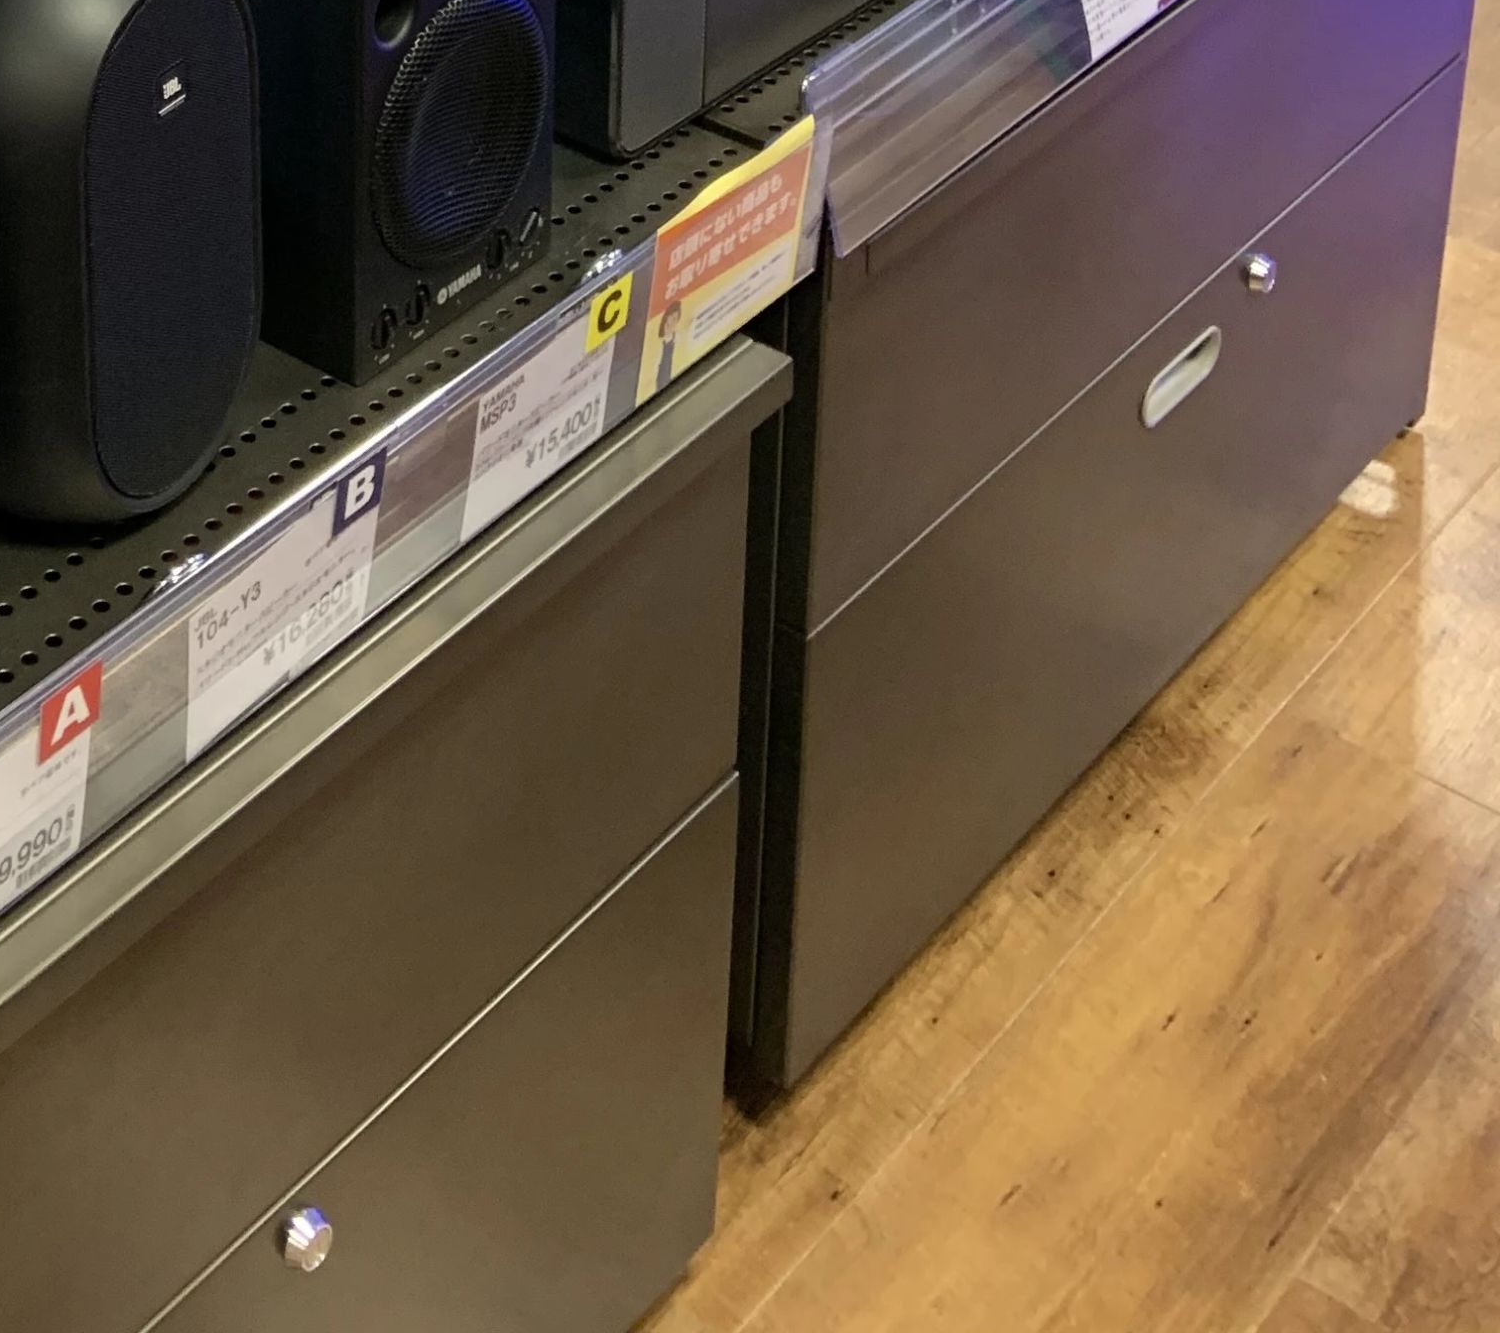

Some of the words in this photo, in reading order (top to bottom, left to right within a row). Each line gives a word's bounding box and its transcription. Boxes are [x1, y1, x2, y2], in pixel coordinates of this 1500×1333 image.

[163, 77, 182, 100] JBL
[447, 264, 481, 298] YAMAHA
[597, 290, 622, 333] C
[480, 393, 517, 433] MSP3
[525, 405, 593, 469] ¥15,400
[344, 465, 375, 521] B
[196, 581, 262, 649] 104-Y3
[51, 685, 90, 746] A
